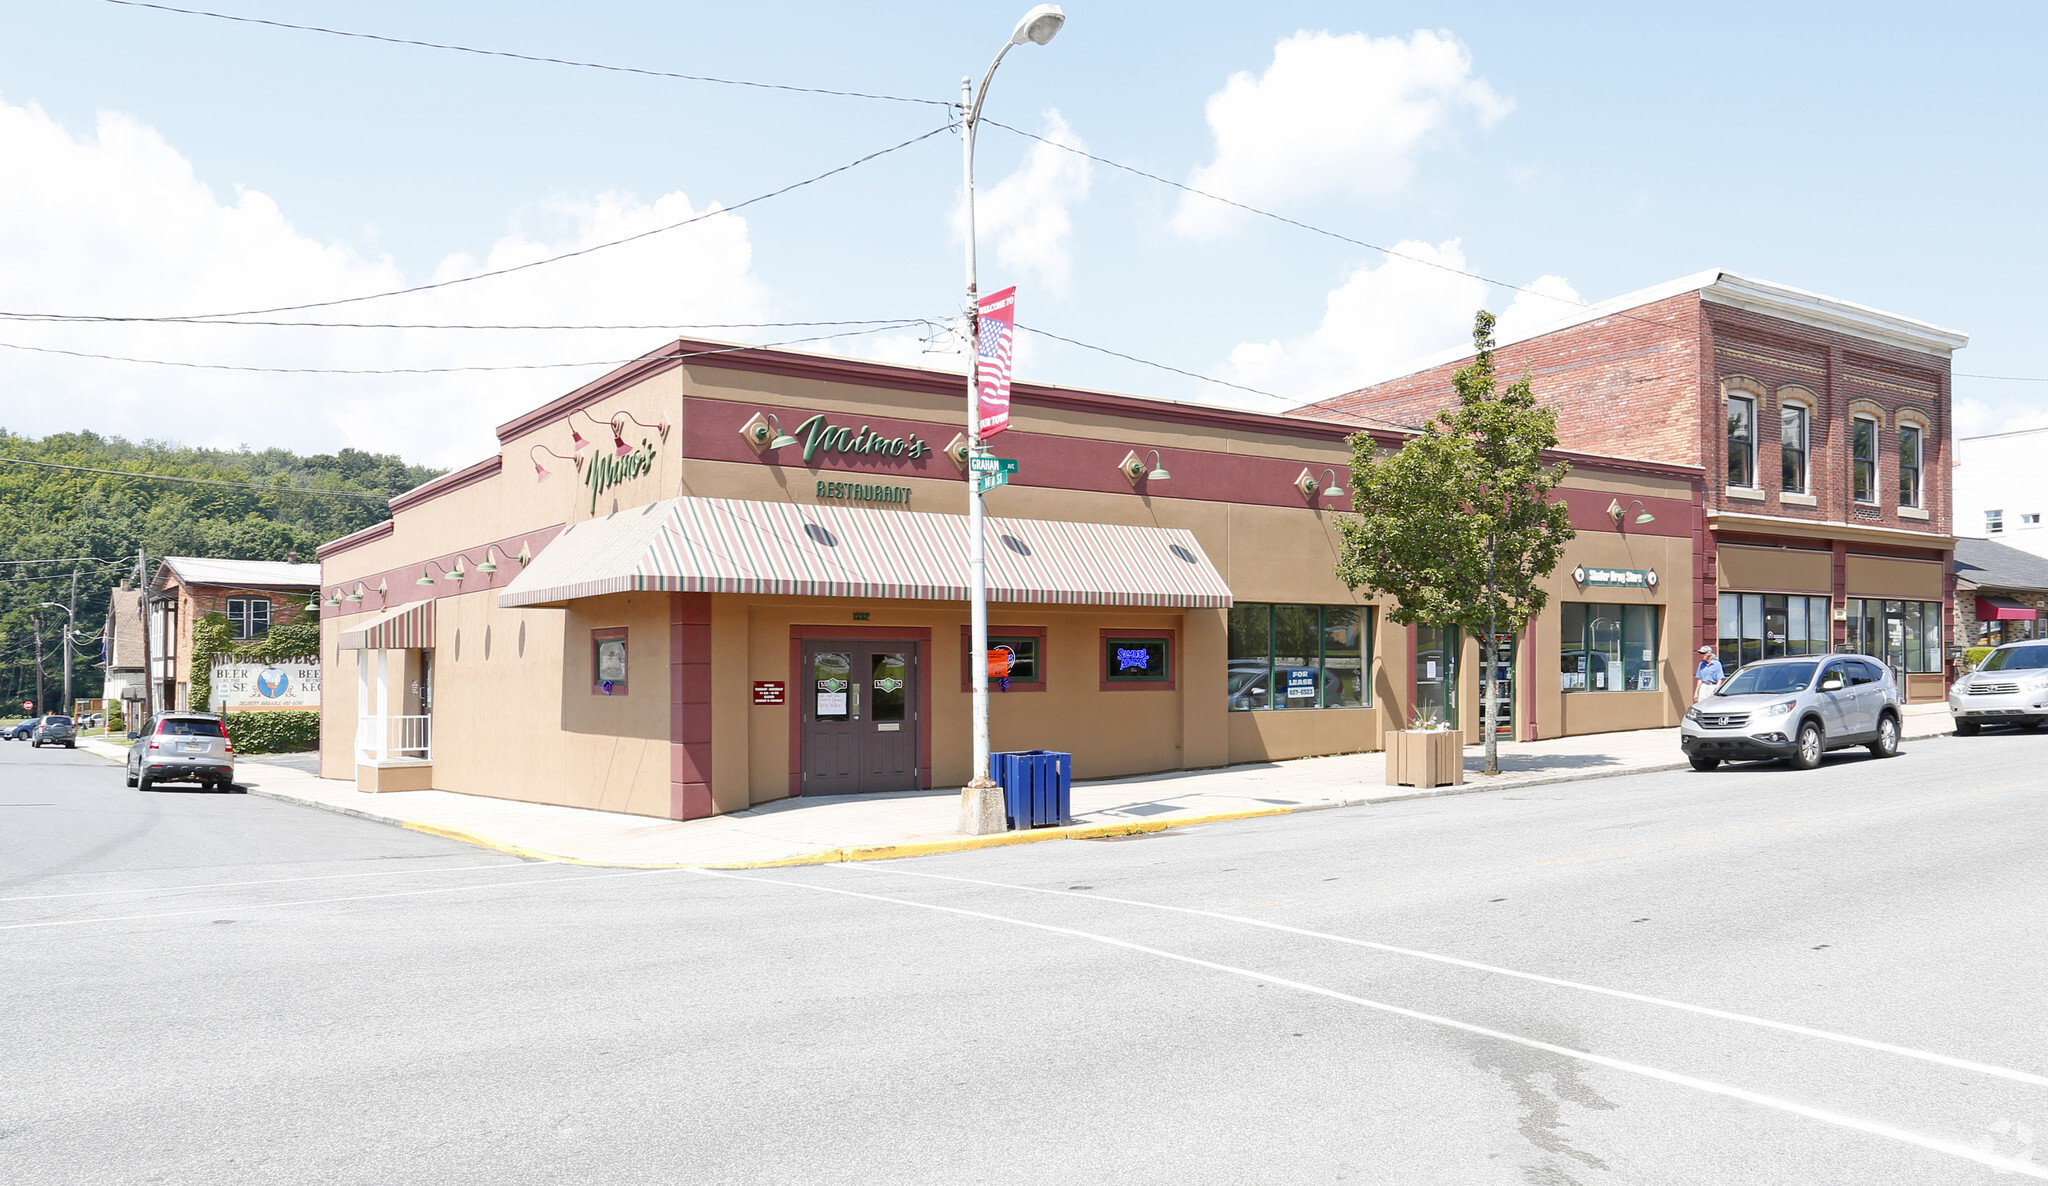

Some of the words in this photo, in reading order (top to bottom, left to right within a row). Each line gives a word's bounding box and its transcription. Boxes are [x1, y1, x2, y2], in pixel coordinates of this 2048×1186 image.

[979, 299, 1005, 315] WELCOME
[1006, 296, 1014, 306] TO
[991, 411, 1009, 425] TOWN
[972, 458, 999, 471] GRAHAM
[816, 480, 911, 504] RESTAURANT
[217, 670, 248, 679] BEER
